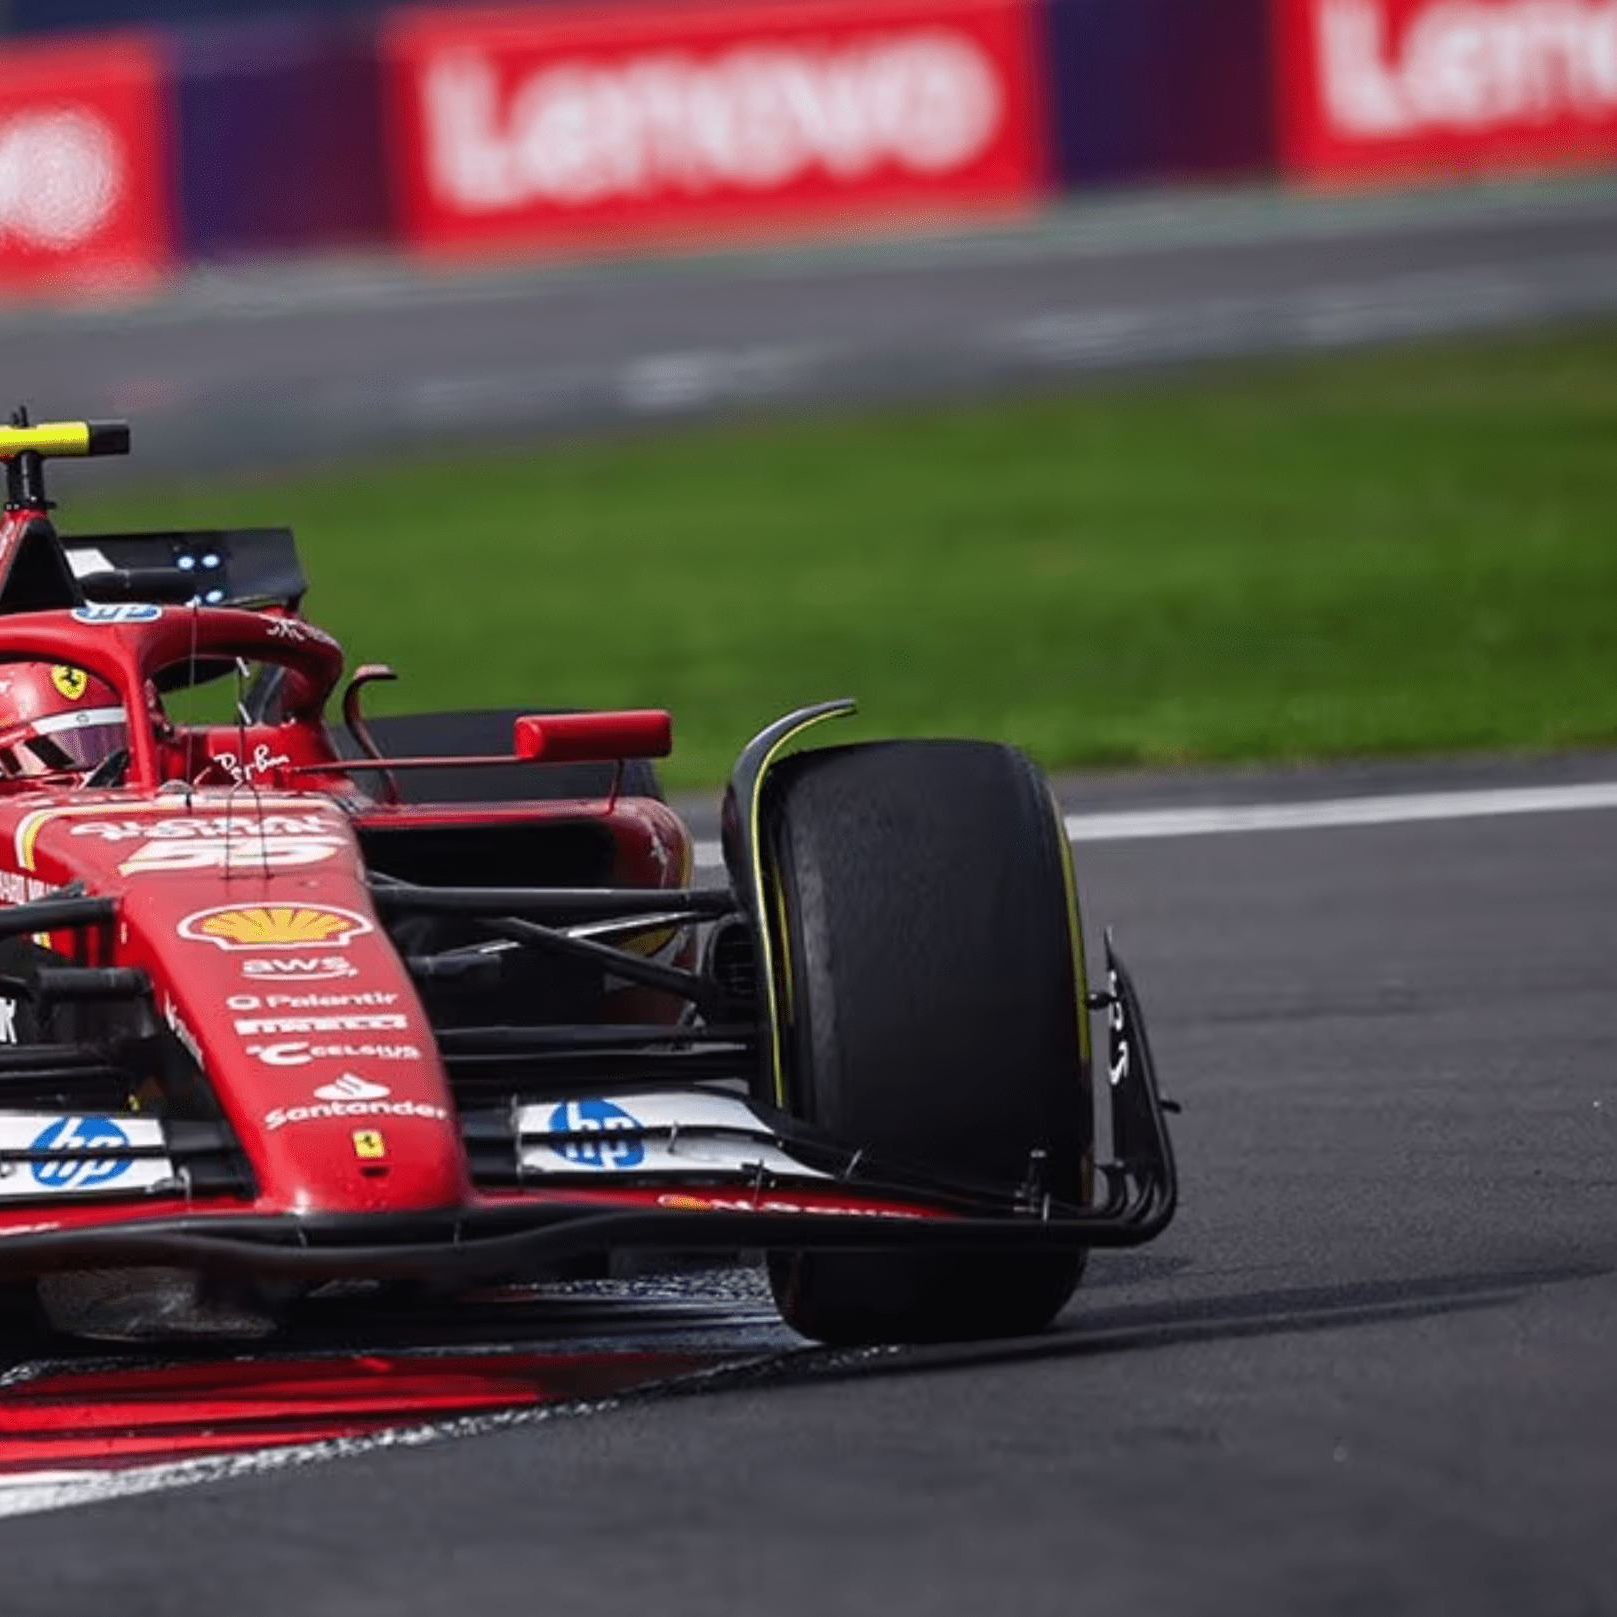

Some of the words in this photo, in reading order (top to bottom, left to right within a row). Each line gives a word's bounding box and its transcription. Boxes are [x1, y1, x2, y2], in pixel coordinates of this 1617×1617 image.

[1313, 0, 1617, 138] Len
[422, 25, 1006, 214] Lenovo
[118, 836, 348, 878] 55
[242, 956, 352, 975] aws
[266, 992, 399, 1008] Palantir
[264, 1100, 448, 1131] Santander
[564, 1101, 637, 1169] hp
[36, 1116, 125, 1189] hp
